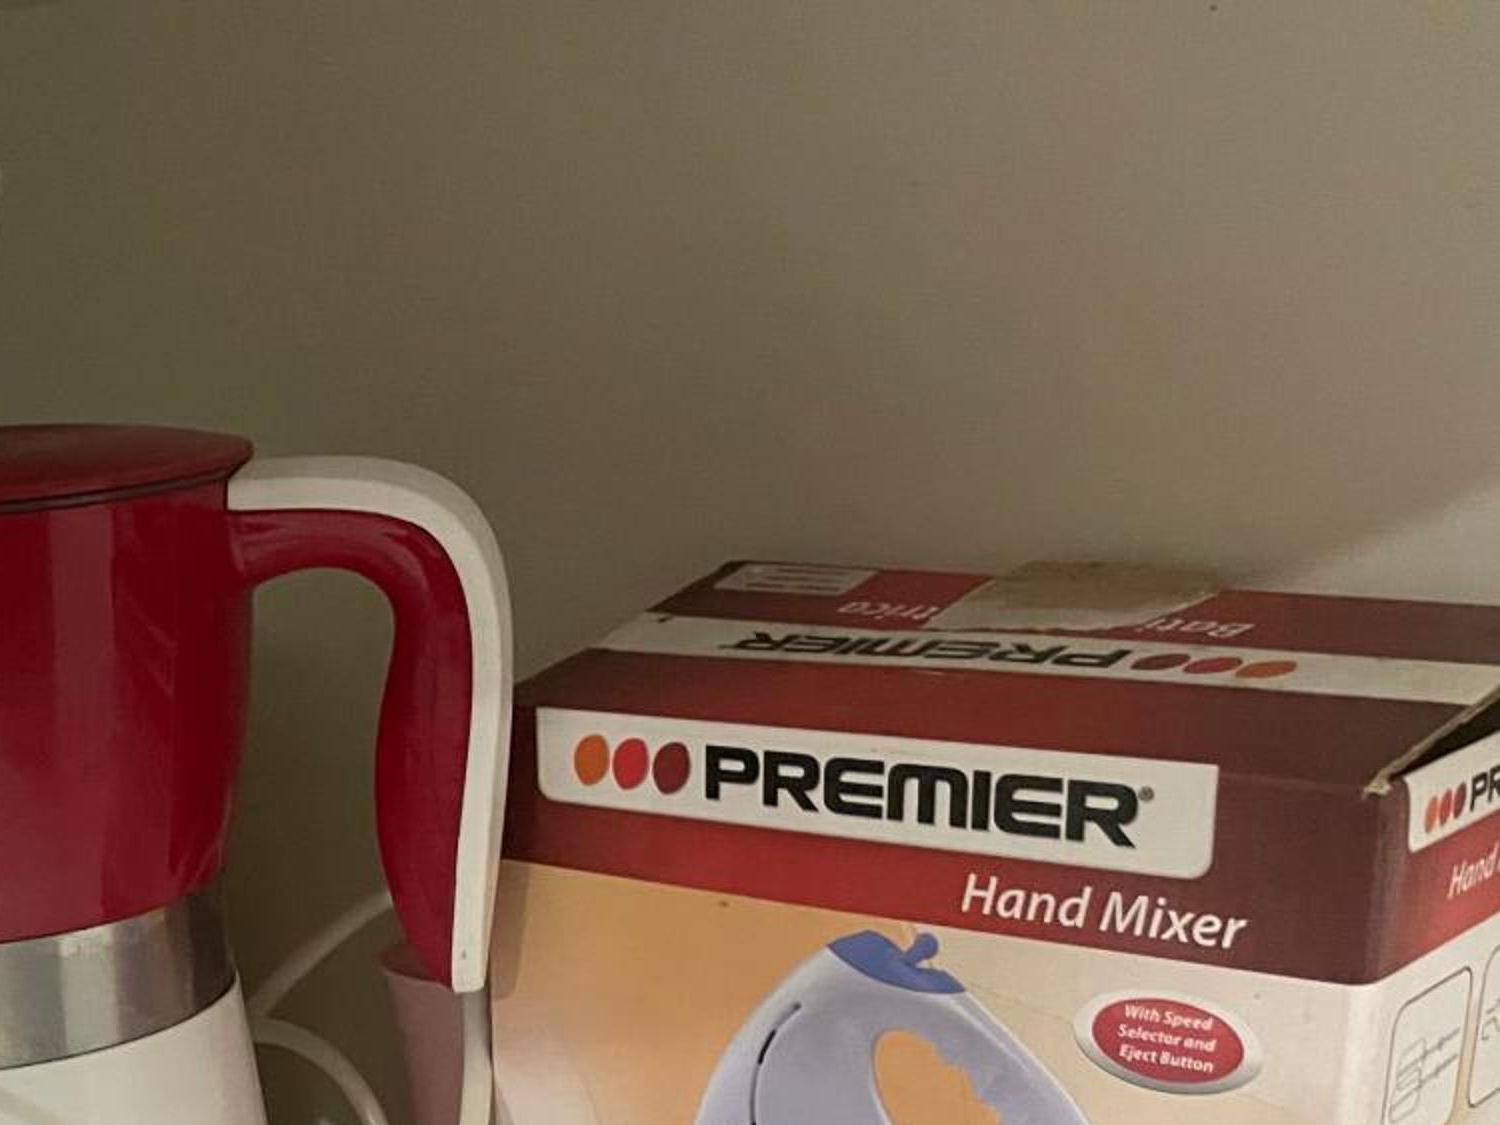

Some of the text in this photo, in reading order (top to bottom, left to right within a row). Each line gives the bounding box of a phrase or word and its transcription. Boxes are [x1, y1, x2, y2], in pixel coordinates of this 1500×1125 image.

[718, 631, 1133, 668] PREMIER
[704, 744, 1139, 848] PREMIER
[960, 872, 1248, 949] Hand Mixer
[1124, 1004, 1214, 1031] With Speed
[1117, 1023, 1217, 1052] Selector and
[1119, 1043, 1214, 1073] Eject Button
